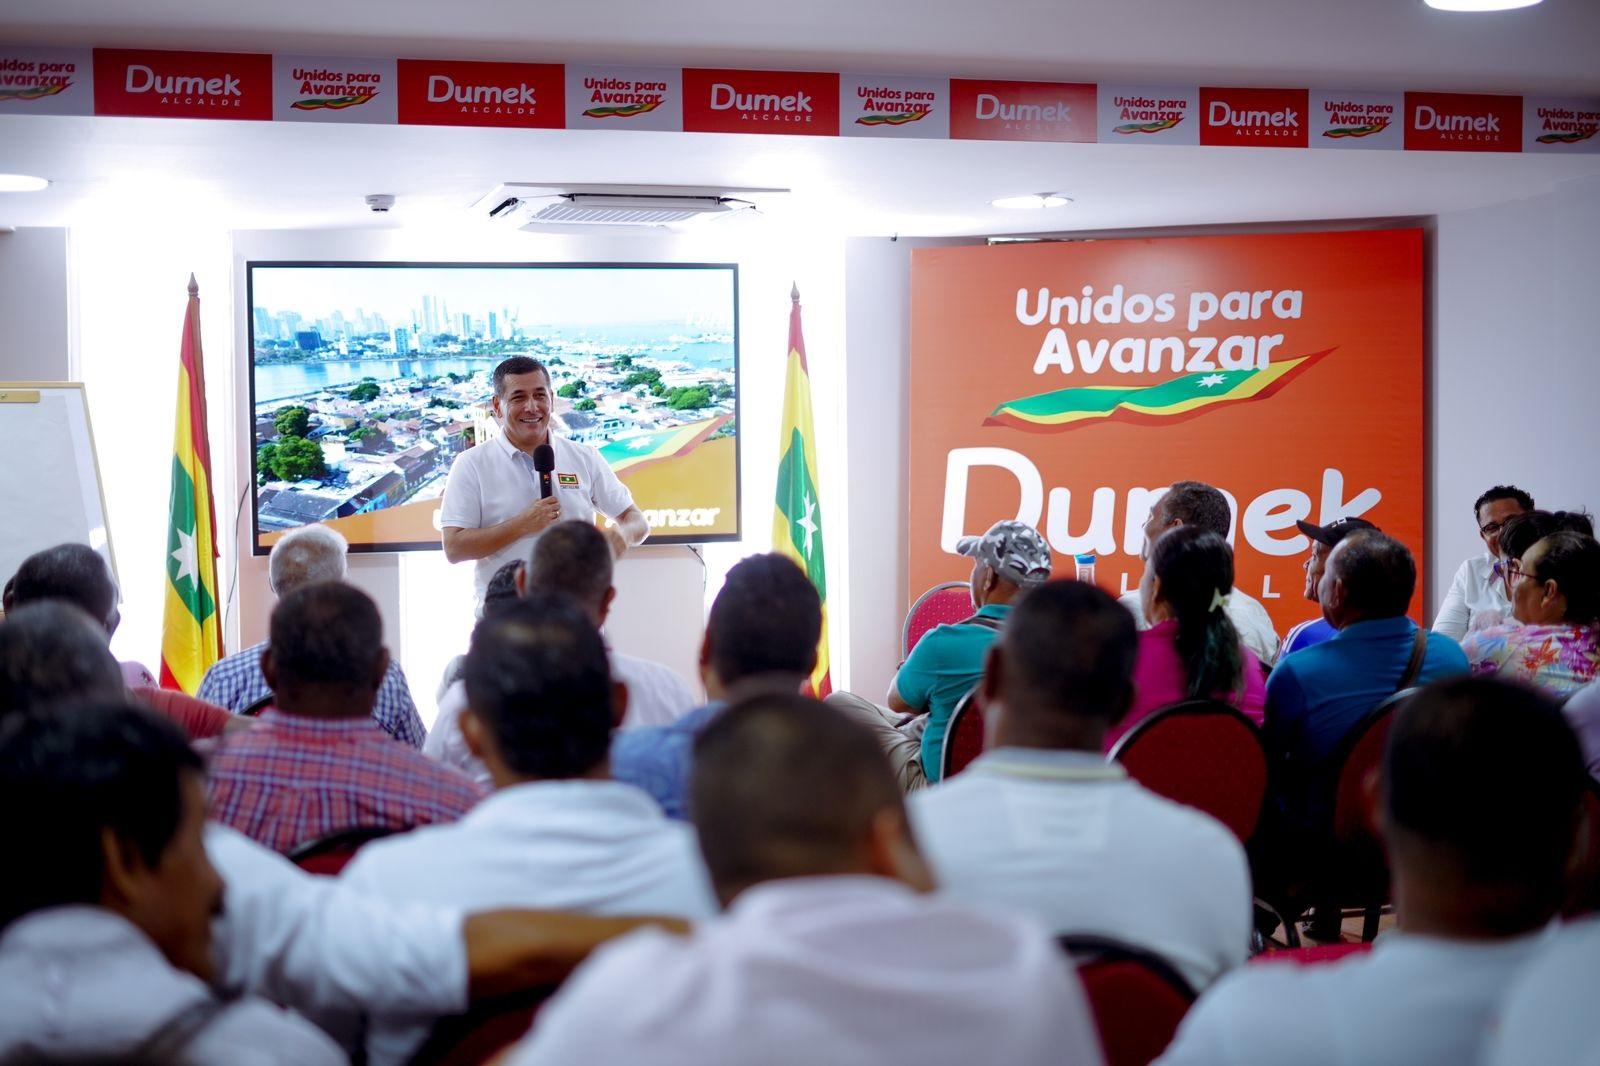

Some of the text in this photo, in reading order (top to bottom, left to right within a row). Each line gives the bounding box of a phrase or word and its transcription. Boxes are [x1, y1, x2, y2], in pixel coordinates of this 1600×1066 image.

[39, 63, 75, 75] para
[292, 68, 381, 85] Unidos para
[0, 74, 69, 87] vanzar
[126, 64, 242, 96] Dumek
[584, 77, 667, 94] Unidos para
[300, 81, 376, 97] Avanzar
[427, 75, 537, 105] Dumek
[857, 86, 935, 102] Unidos para
[161, 97, 241, 107] ALCALDE
[590, 89, 662, 105] Avanzar
[710, 83, 813, 113] Dumek
[1114, 96, 1187, 111] Unidos para
[461, 106, 536, 115] ALCALDE
[863, 98, 931, 113] Avanzar
[975, 93, 1072, 122] Dumek
[1324, 101, 1393, 116] Unidos para
[742, 113, 812, 122] ALCALDE
[1119, 108, 1183, 121] Avanzar
[1208, 100, 1299, 127] Dumek
[1330, 111, 1389, 126] Avanzar
[1414, 105, 1501, 132] Dumek
[1537, 108, 1574, 119] Unidos
[1236, 129, 1298, 137] ALCALDE
[1543, 119, 1598, 134] Avanzar
[1440, 133, 1500, 141] ALCALDE
[1015, 284, 1303, 332] Unidos para
[1033, 327, 1284, 375] Avanzar
